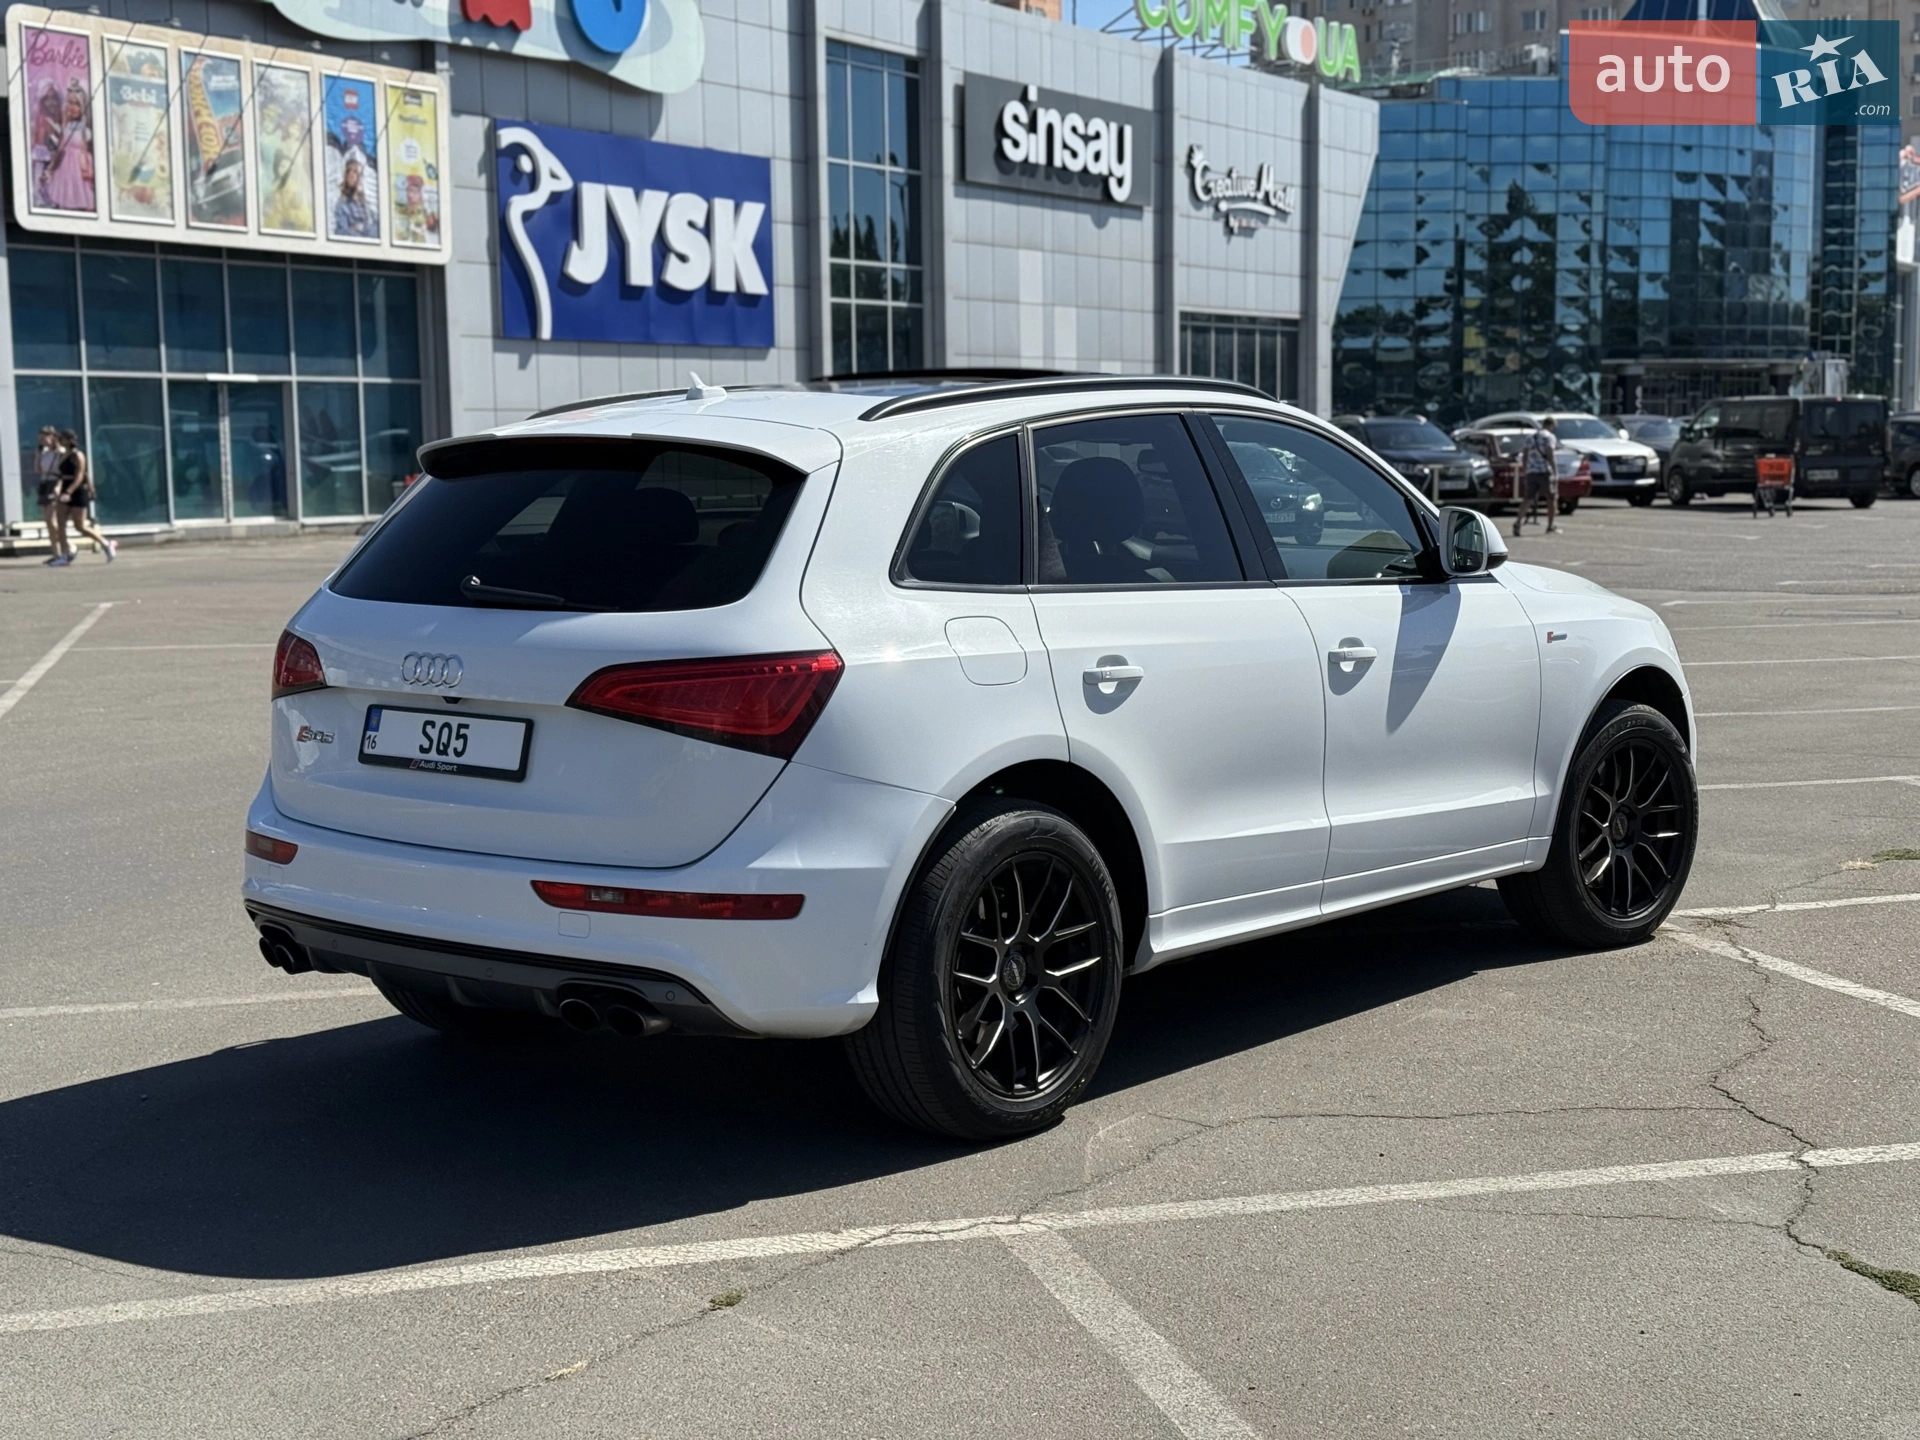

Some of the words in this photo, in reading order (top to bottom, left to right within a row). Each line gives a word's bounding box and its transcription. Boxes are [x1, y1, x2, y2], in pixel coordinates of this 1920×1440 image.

[27, 31, 89, 69] Barbie
[1001, 84, 1132, 202] sinsay
[563, 181, 769, 295] JYSK
[365, 734, 378, 750] 16
[419, 720, 470, 758] SQ5
[419, 760, 436, 769] Audi
[436, 761, 458, 772] Sport
